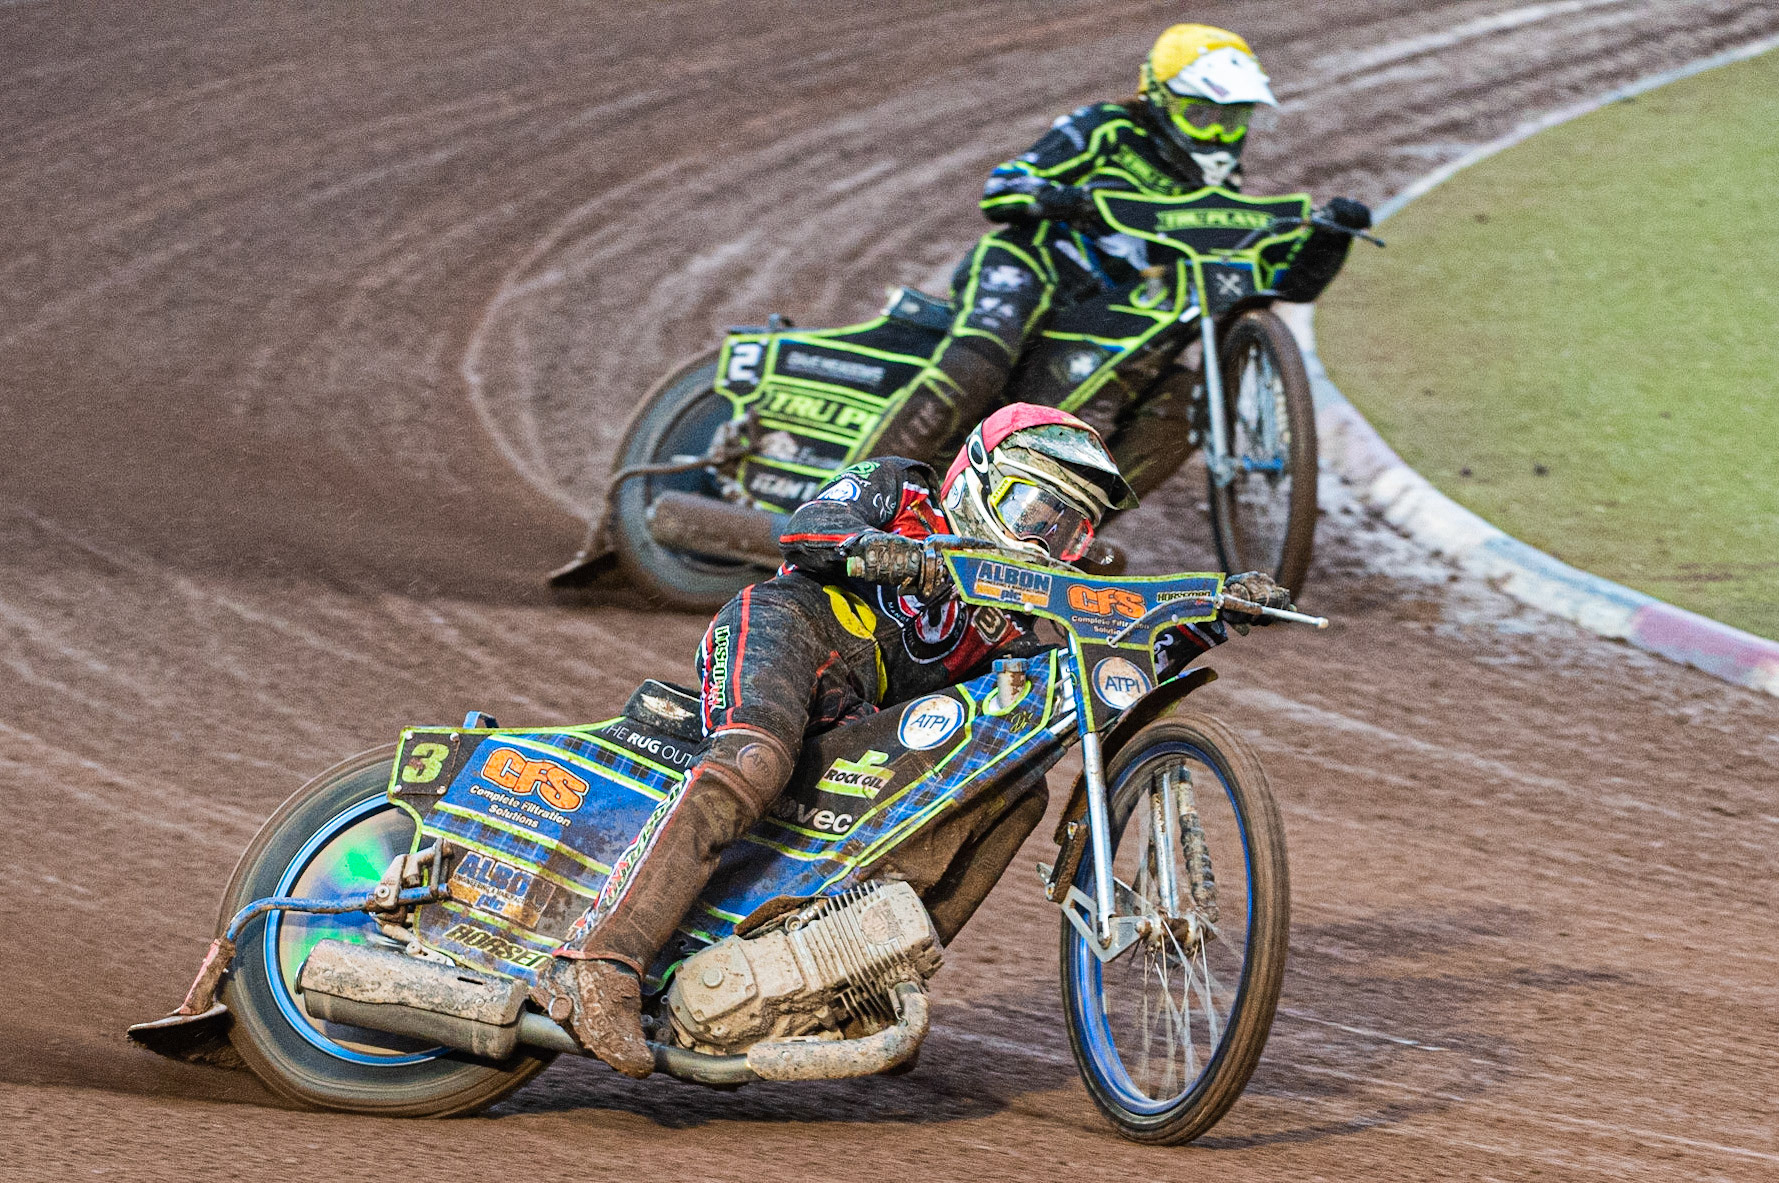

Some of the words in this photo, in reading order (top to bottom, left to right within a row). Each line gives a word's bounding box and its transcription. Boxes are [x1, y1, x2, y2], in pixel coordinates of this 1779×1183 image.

[729, 344, 762, 381] 2
[979, 561, 1050, 591] ALBON
[1067, 584, 1147, 620] CFS
[1071, 615, 1110, 627] Complete
[1104, 674, 1140, 695] ATPI
[909, 713, 951, 732] ATPI
[402, 742, 449, 783] 3
[626, 732, 662, 754] RUG
[661, 745, 692, 768] OUT
[481, 747, 590, 812] CFS
[824, 768, 862, 786] ROCK
[861, 774, 884, 789] OIL
[470, 784, 520, 808] Complete
[520, 801, 572, 827] Filtration
[488, 804, 539, 828] Solutions
